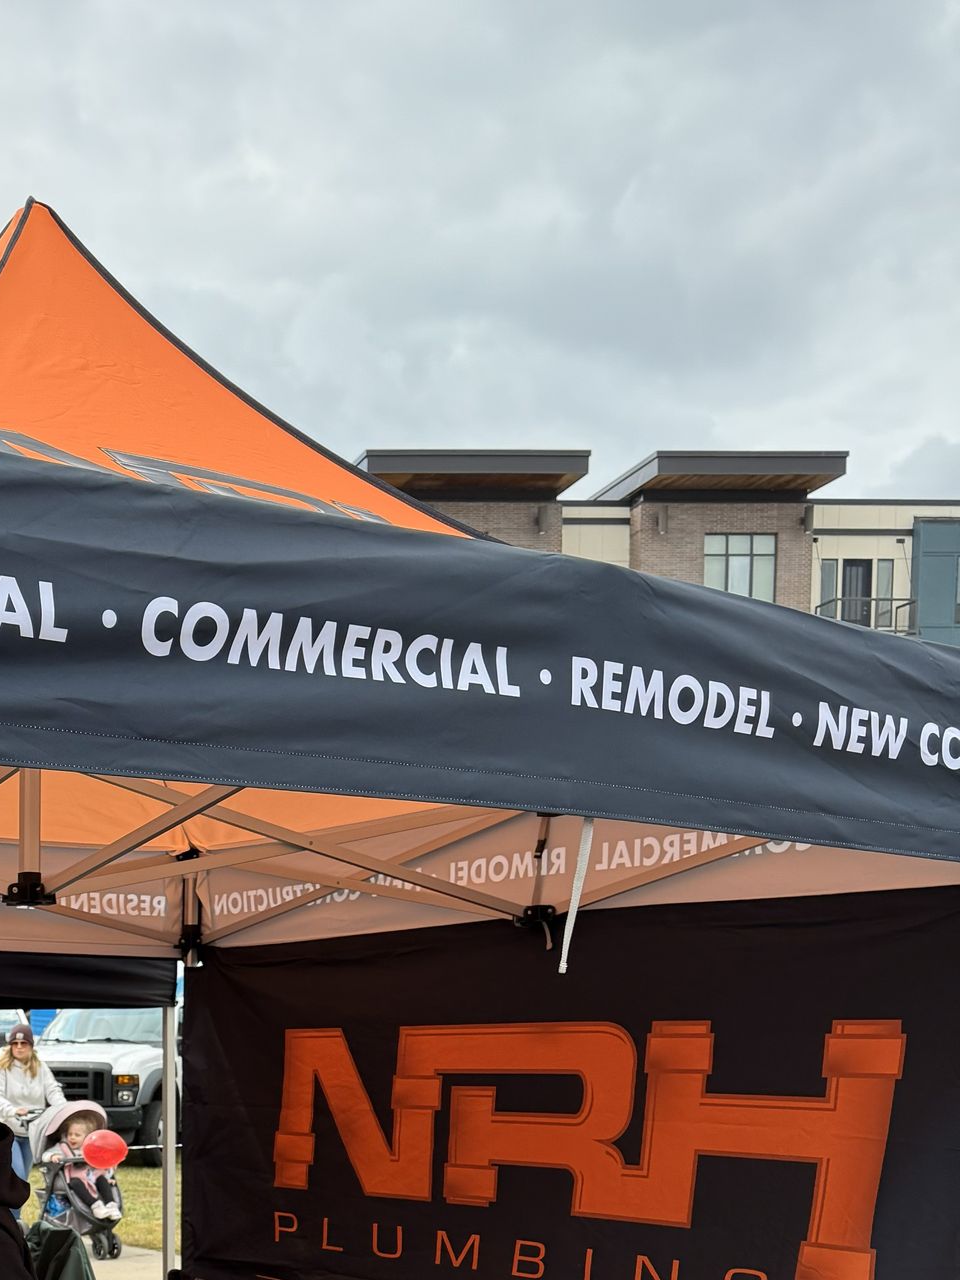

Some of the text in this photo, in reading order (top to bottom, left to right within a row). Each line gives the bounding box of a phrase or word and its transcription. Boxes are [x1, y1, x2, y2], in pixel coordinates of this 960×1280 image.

[142, 595, 520, 698] COMMERCIAL
[570, 657, 775, 739] REMODEL
[812, 700, 908, 760] NEW
